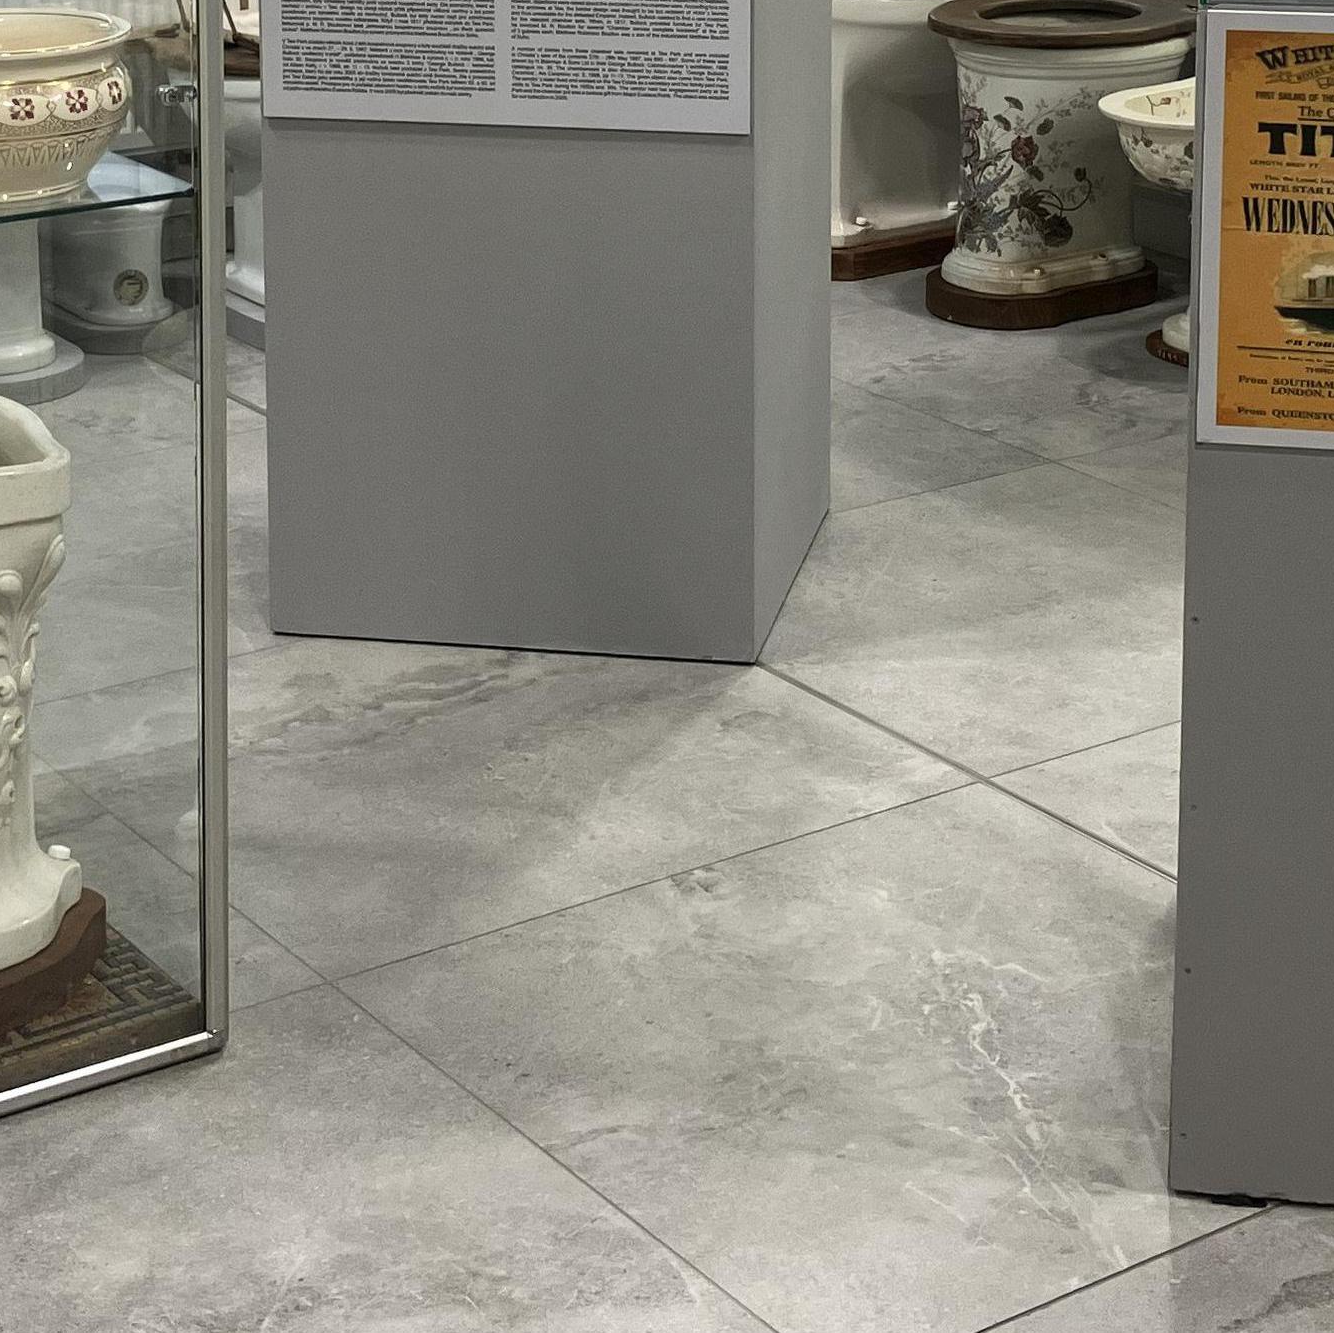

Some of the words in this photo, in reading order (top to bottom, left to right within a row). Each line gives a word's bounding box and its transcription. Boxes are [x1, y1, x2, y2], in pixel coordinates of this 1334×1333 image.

[1255, 91, 1275, 100] FIRST
[1278, 91, 1306, 101] SAILING
[1309, 93, 1318, 101] OF
[1321, 93, 1334, 102] THE
[1297, 106, 1323, 117] The
[1250, 183, 1289, 193] WHITE
[1291, 185, 1327, 195] STAR
[1286, 339, 1303, 347] en
[1238, 375, 1267, 384] From
[1271, 388, 1325, 398] LONDON,
[1238, 407, 1267, 416] From
